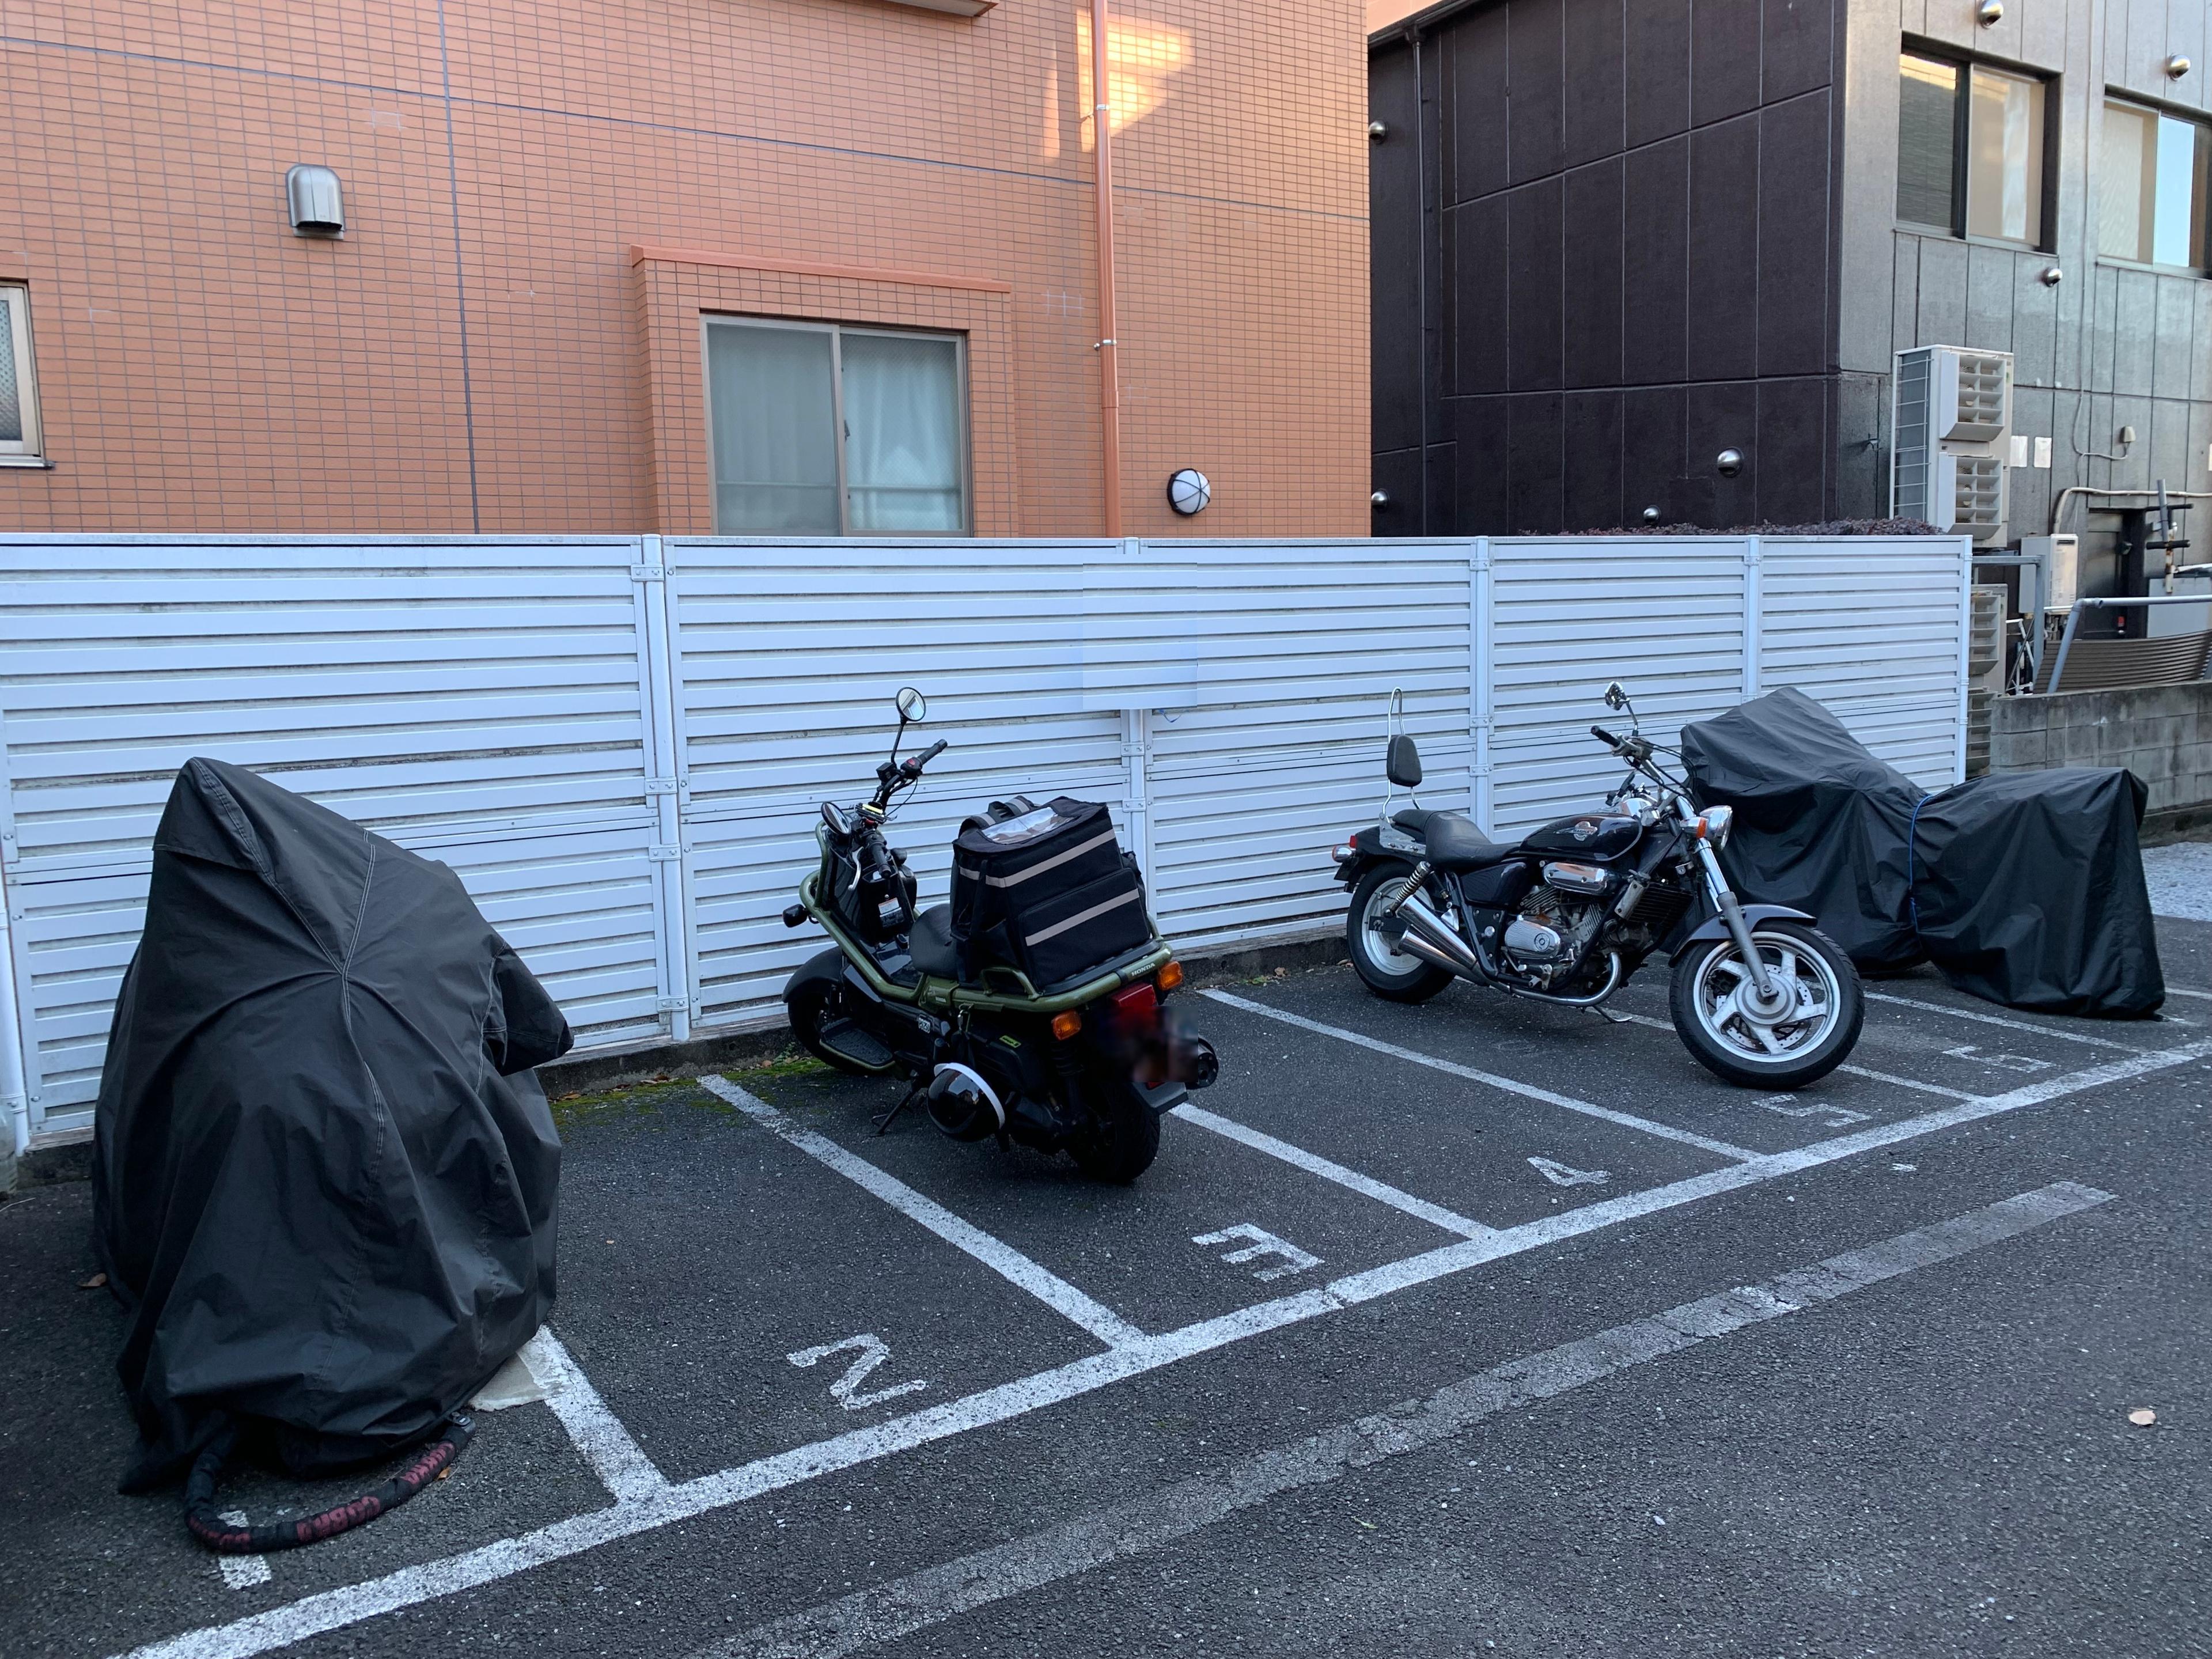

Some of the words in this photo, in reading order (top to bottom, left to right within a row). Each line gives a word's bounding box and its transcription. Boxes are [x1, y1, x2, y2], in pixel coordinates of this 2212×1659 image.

[1131, 963, 1156, 976] HONDA
[1751, 1094, 1873, 1127] 5
[1527, 1156, 1612, 1187] 4
[1191, 1223, 1325, 1282] 3
[786, 1333, 926, 1411] 2
